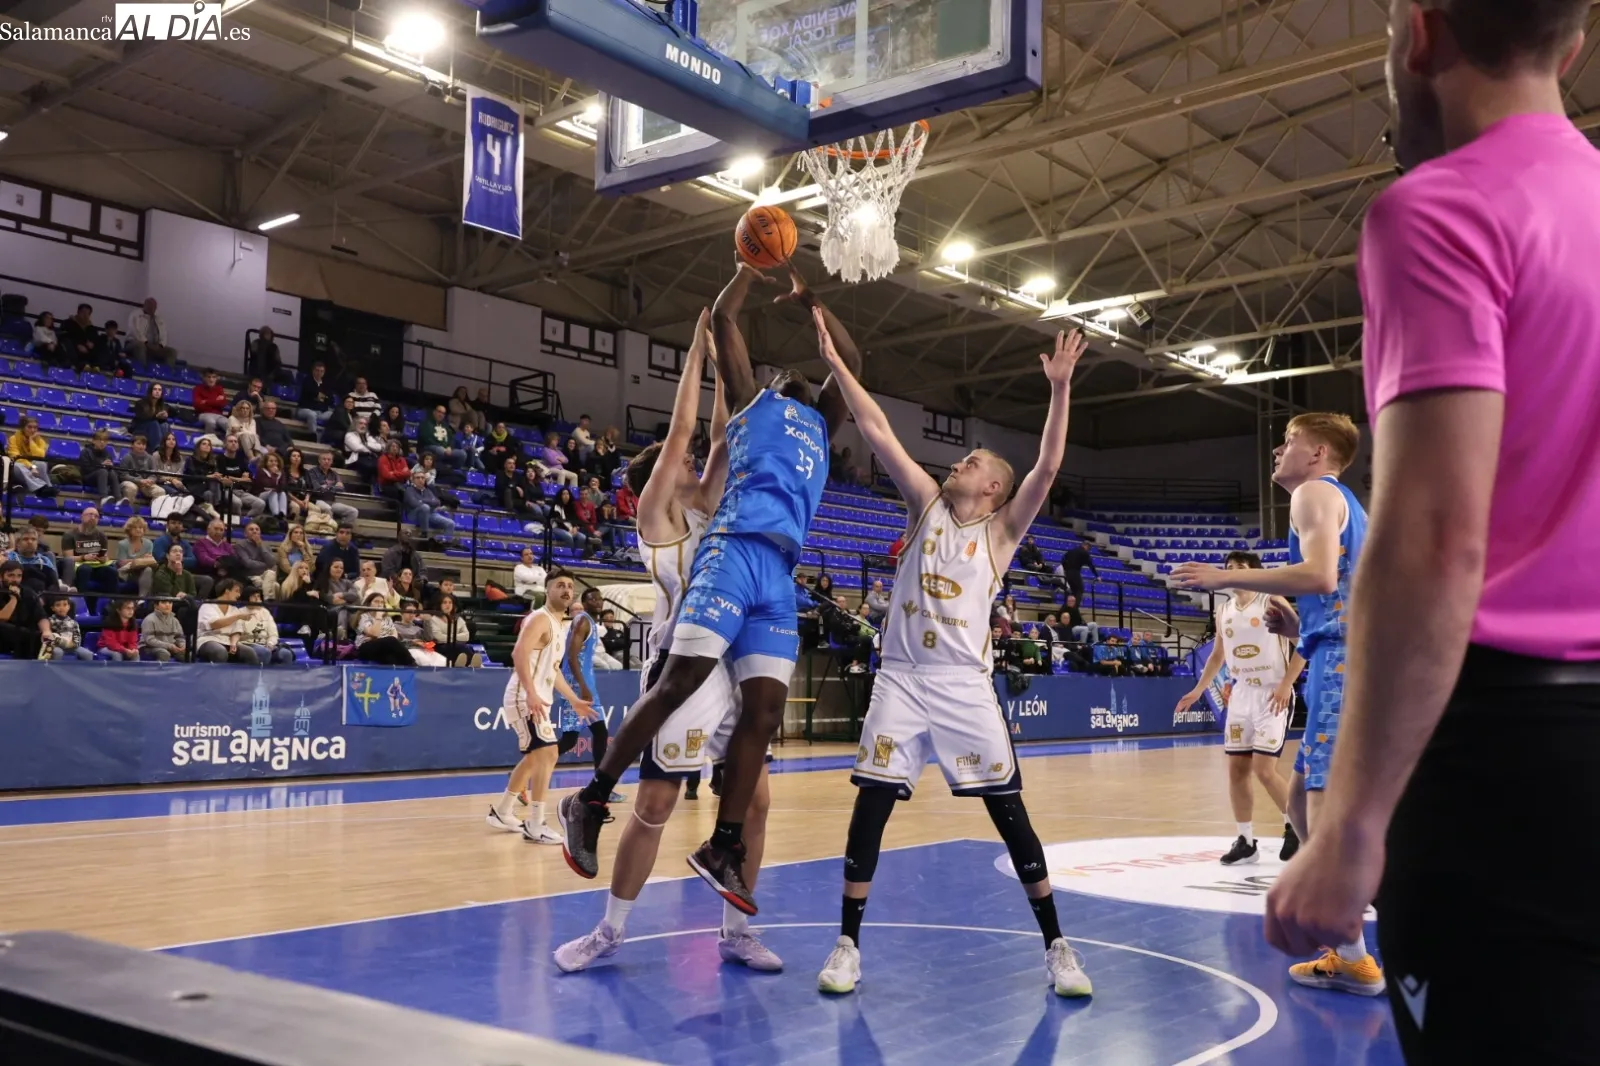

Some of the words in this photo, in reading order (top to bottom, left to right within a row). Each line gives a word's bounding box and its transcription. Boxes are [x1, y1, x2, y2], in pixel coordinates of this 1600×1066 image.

[665, 43, 722, 85] MONDO
[486, 132, 502, 176] 4
[941, 616, 969, 628] RURAL
[922, 630, 937, 650] 8
[1007, 700, 1016, 720] Y
[1018, 694, 1048, 717] LEÓN
[174, 722, 231, 738] turismo
